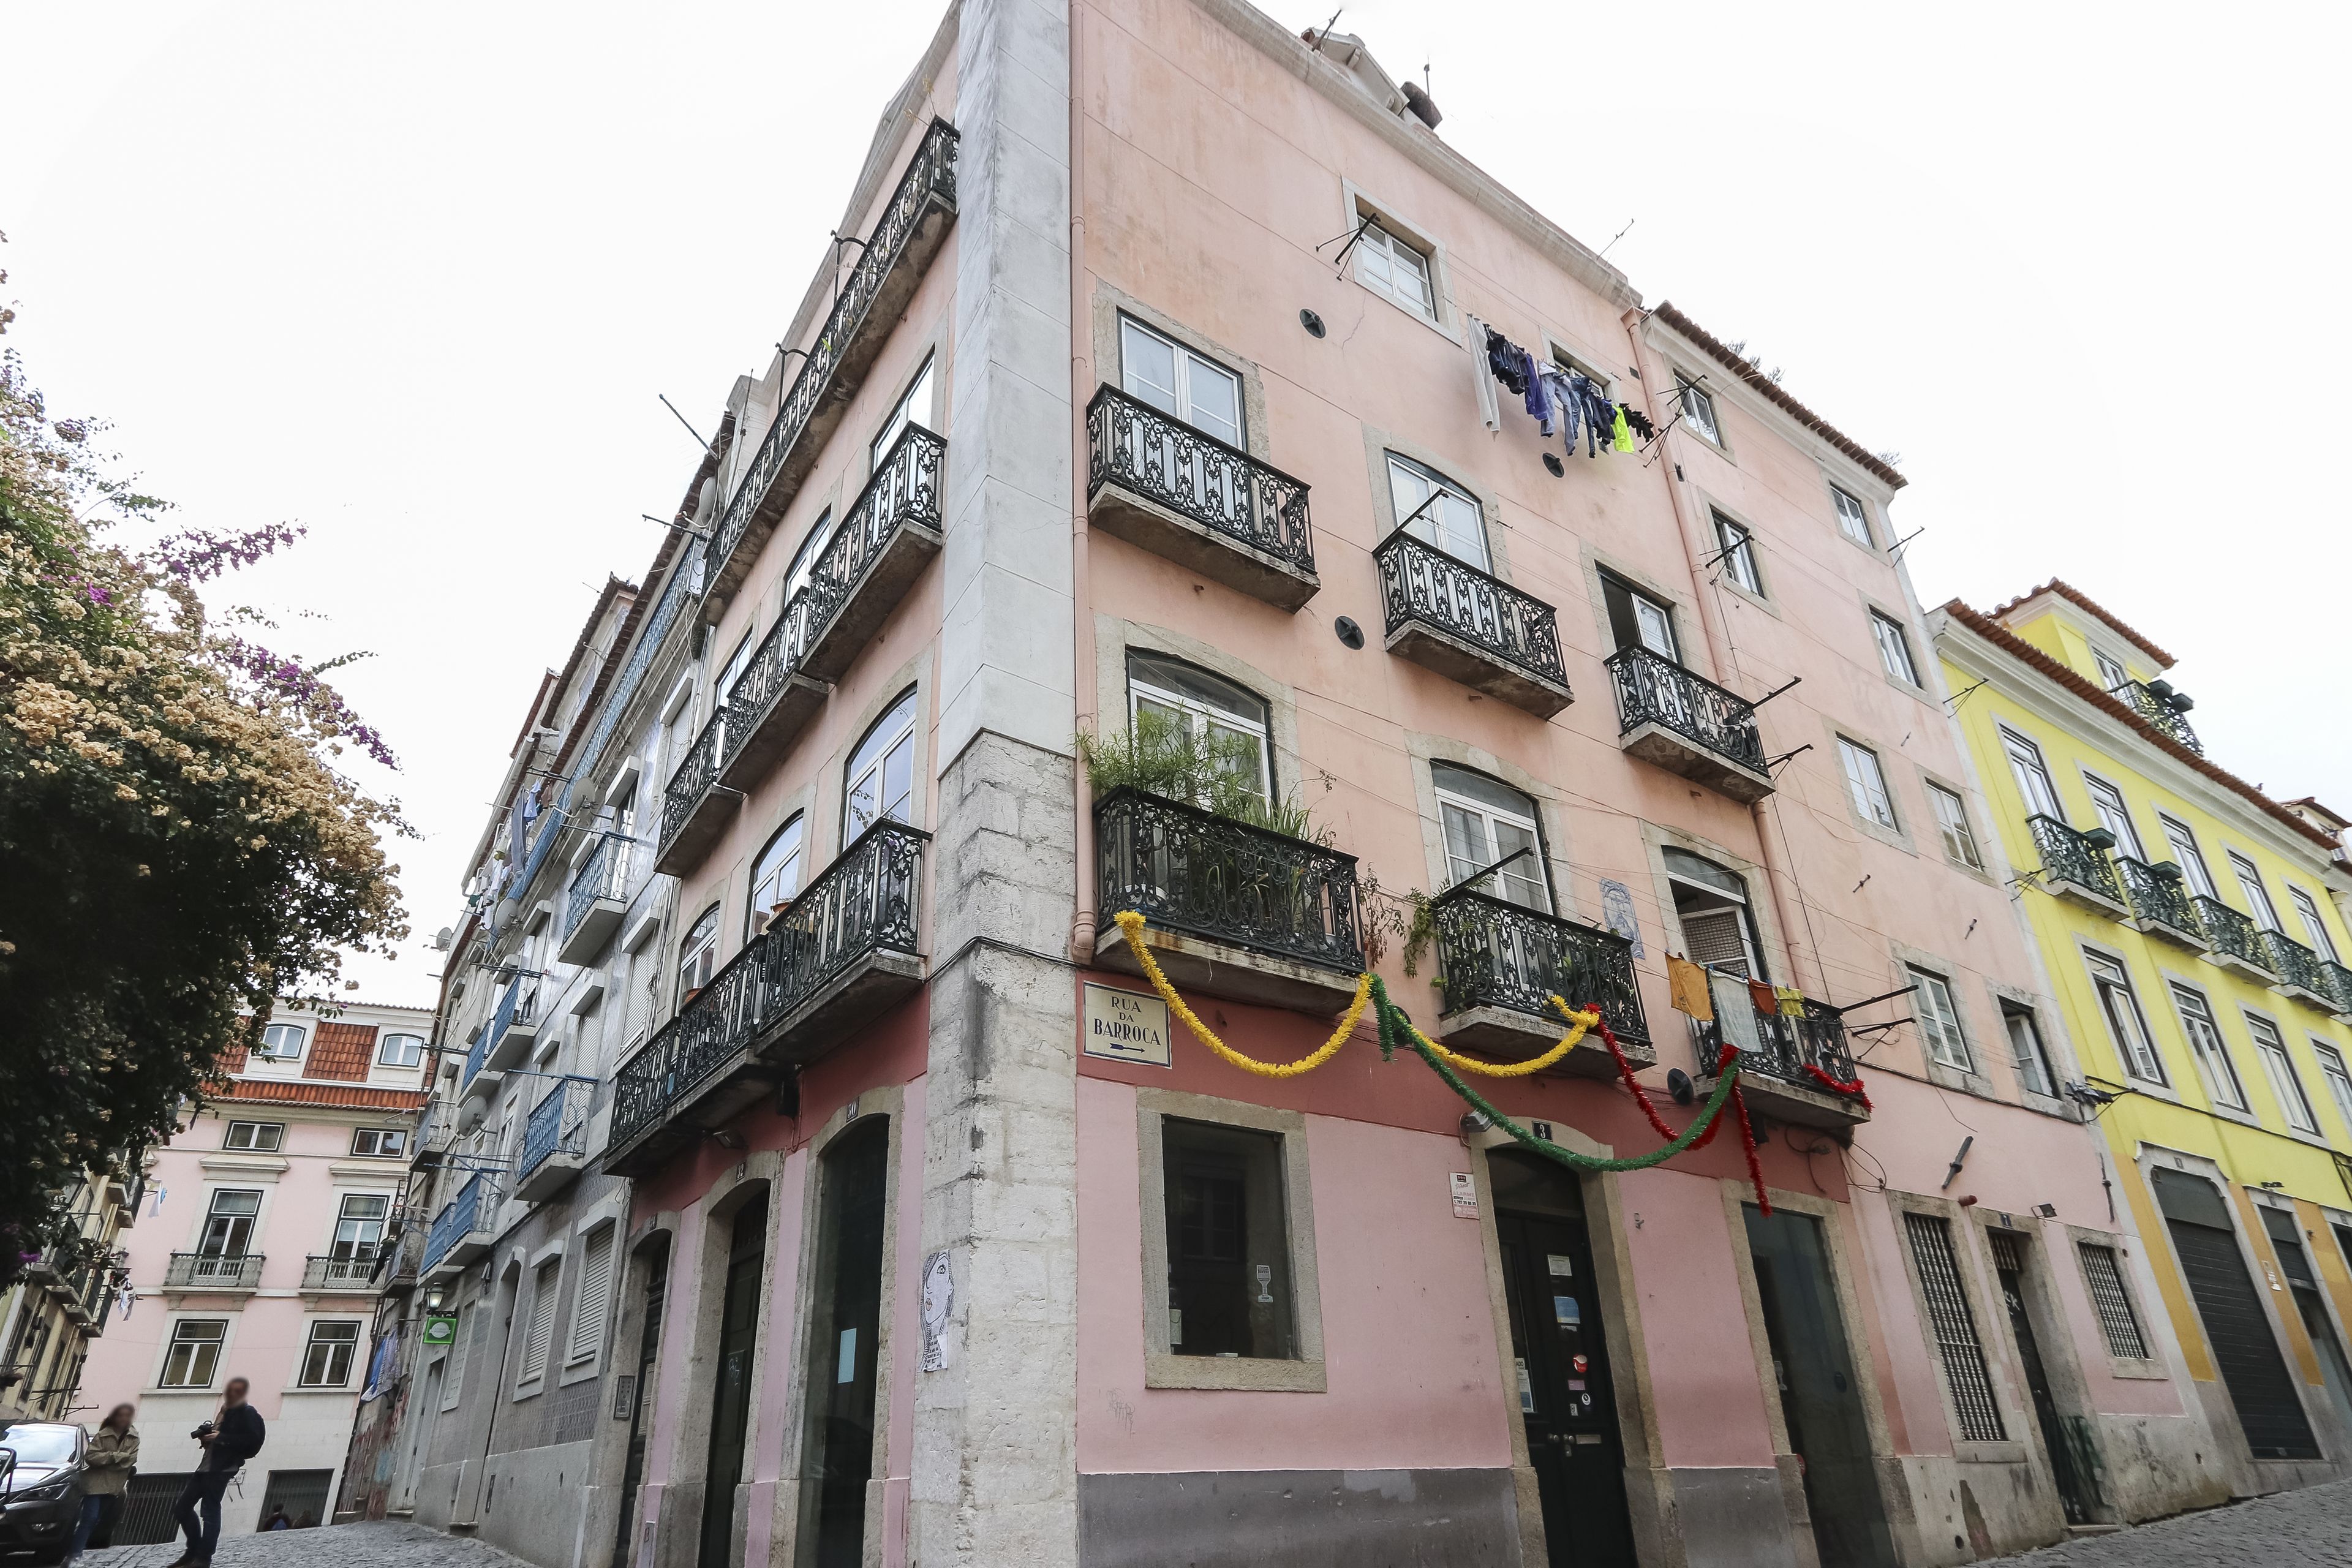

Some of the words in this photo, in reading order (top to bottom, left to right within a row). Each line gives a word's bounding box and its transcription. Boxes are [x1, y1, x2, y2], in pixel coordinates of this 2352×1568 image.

[1111, 996, 1142, 1012] RUA
[1119, 1012, 1134, 1022] DA
[1094, 1018, 1161, 1046] BARROCA
[847, 1102, 856, 1118] 30
[1539, 1124, 1546, 1139] 3
